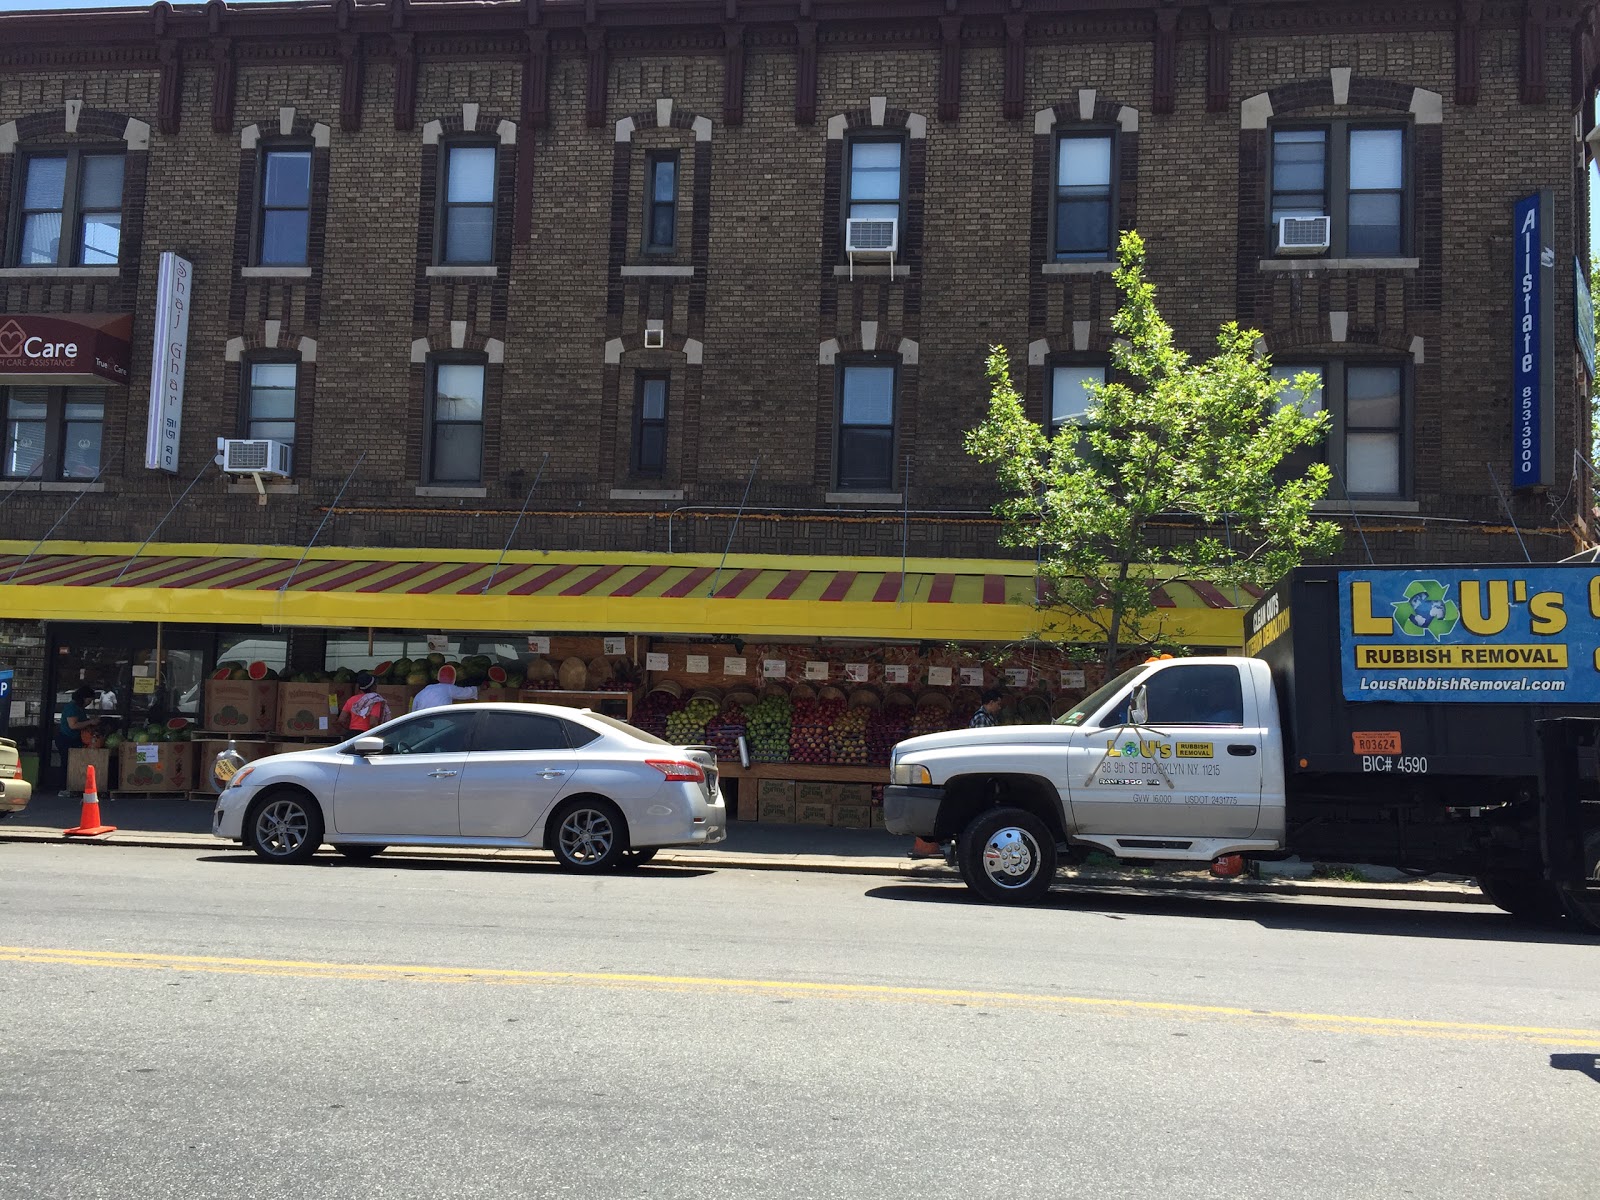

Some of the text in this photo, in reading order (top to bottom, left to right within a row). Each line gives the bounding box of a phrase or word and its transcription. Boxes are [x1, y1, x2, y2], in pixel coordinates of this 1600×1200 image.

[1521, 208, 1535, 373] Allstate
[170, 262, 187, 406] Shaj Ghar
[24, 336, 78, 358] Care
[6, 359, 27, 367] CARE
[29, 359, 75, 367] ASSISTANCE
[96, 357, 127, 376] True Care
[1365, 648, 1559, 664] RUBBISH REMOVAL
[1360, 677, 1566, 691] LousRubbishRemoval.com
[1359, 739, 1395, 750] R03624
[1114, 762, 1126, 774] 9th
[1141, 762, 1185, 775] BROOKLYN
[1202, 764, 1221, 776] 11215
[1362, 755, 1428, 773] BIC# 4590
[1133, 794, 1150, 803] GVW
[1184, 795, 1209, 805] USDOT
[1211, 796, 1238, 805] 2431775
